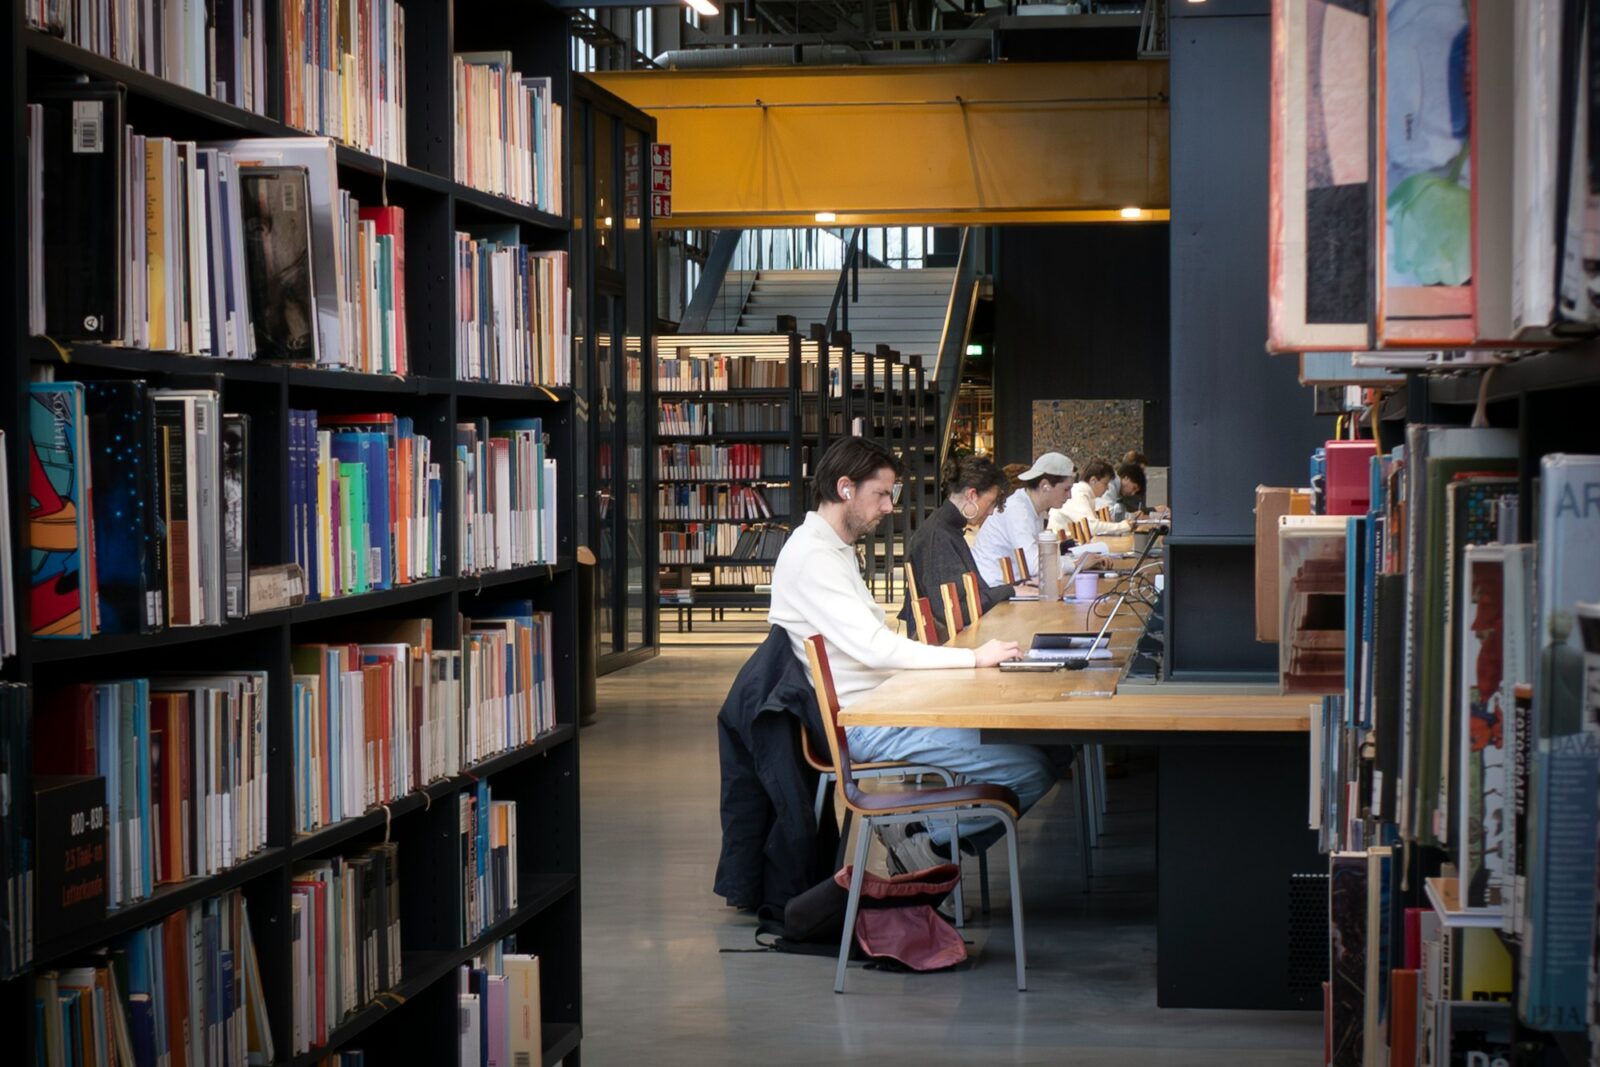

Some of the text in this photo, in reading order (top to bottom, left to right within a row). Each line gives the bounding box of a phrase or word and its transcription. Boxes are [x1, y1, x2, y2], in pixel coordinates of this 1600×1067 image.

[54, 392, 66, 454] PHAIDON
[1515, 706, 1526, 816] FOTOGRAFIE
[71, 812, 84, 835] 800
[90, 807, 103, 830] 830
